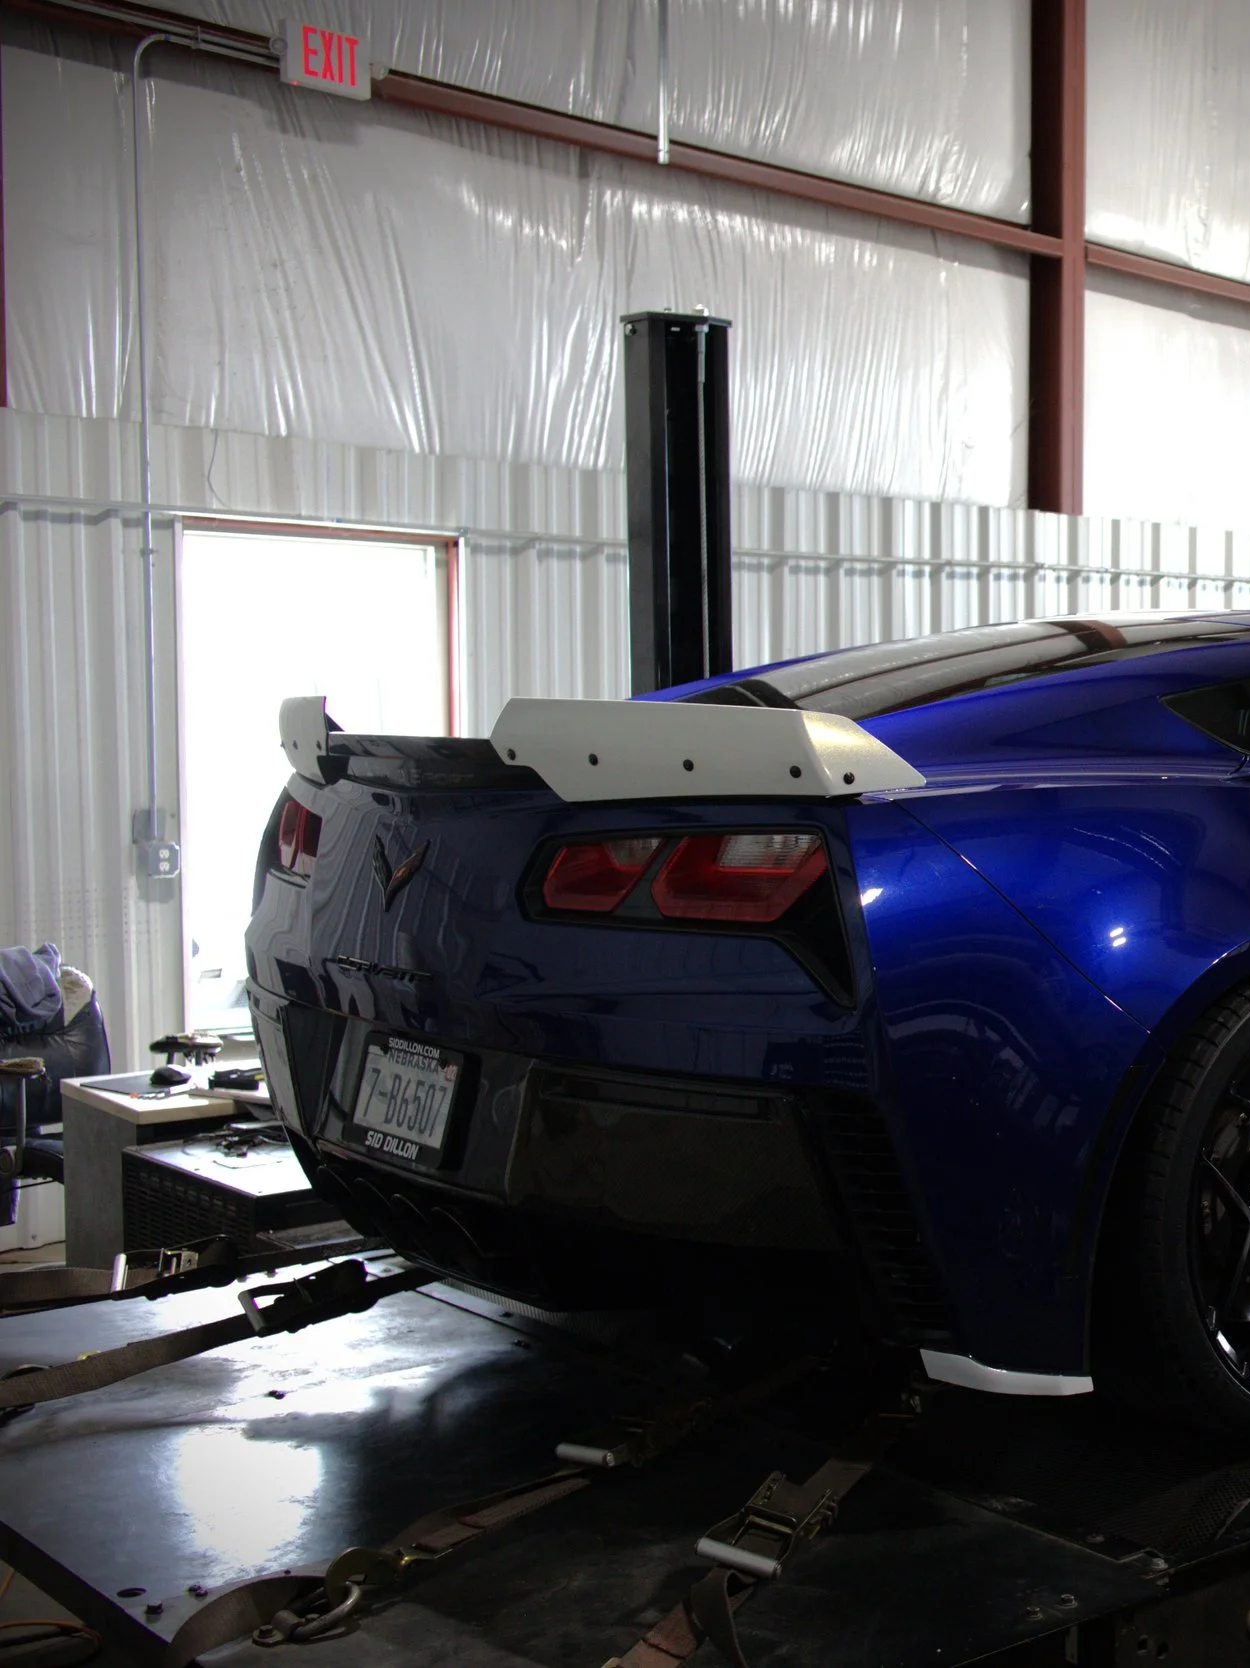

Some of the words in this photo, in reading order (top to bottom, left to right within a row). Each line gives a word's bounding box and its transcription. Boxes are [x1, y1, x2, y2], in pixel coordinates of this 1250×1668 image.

[302, 25, 359, 88] EXIT
[388, 1037, 440, 1059] SIDDILLON.COM
[388, 1049, 439, 1075] NEBRASKA
[363, 1067, 448, 1138] 7-B6507
[365, 1130, 384, 1147] SID
[383, 1134, 420, 1160] DILLON
